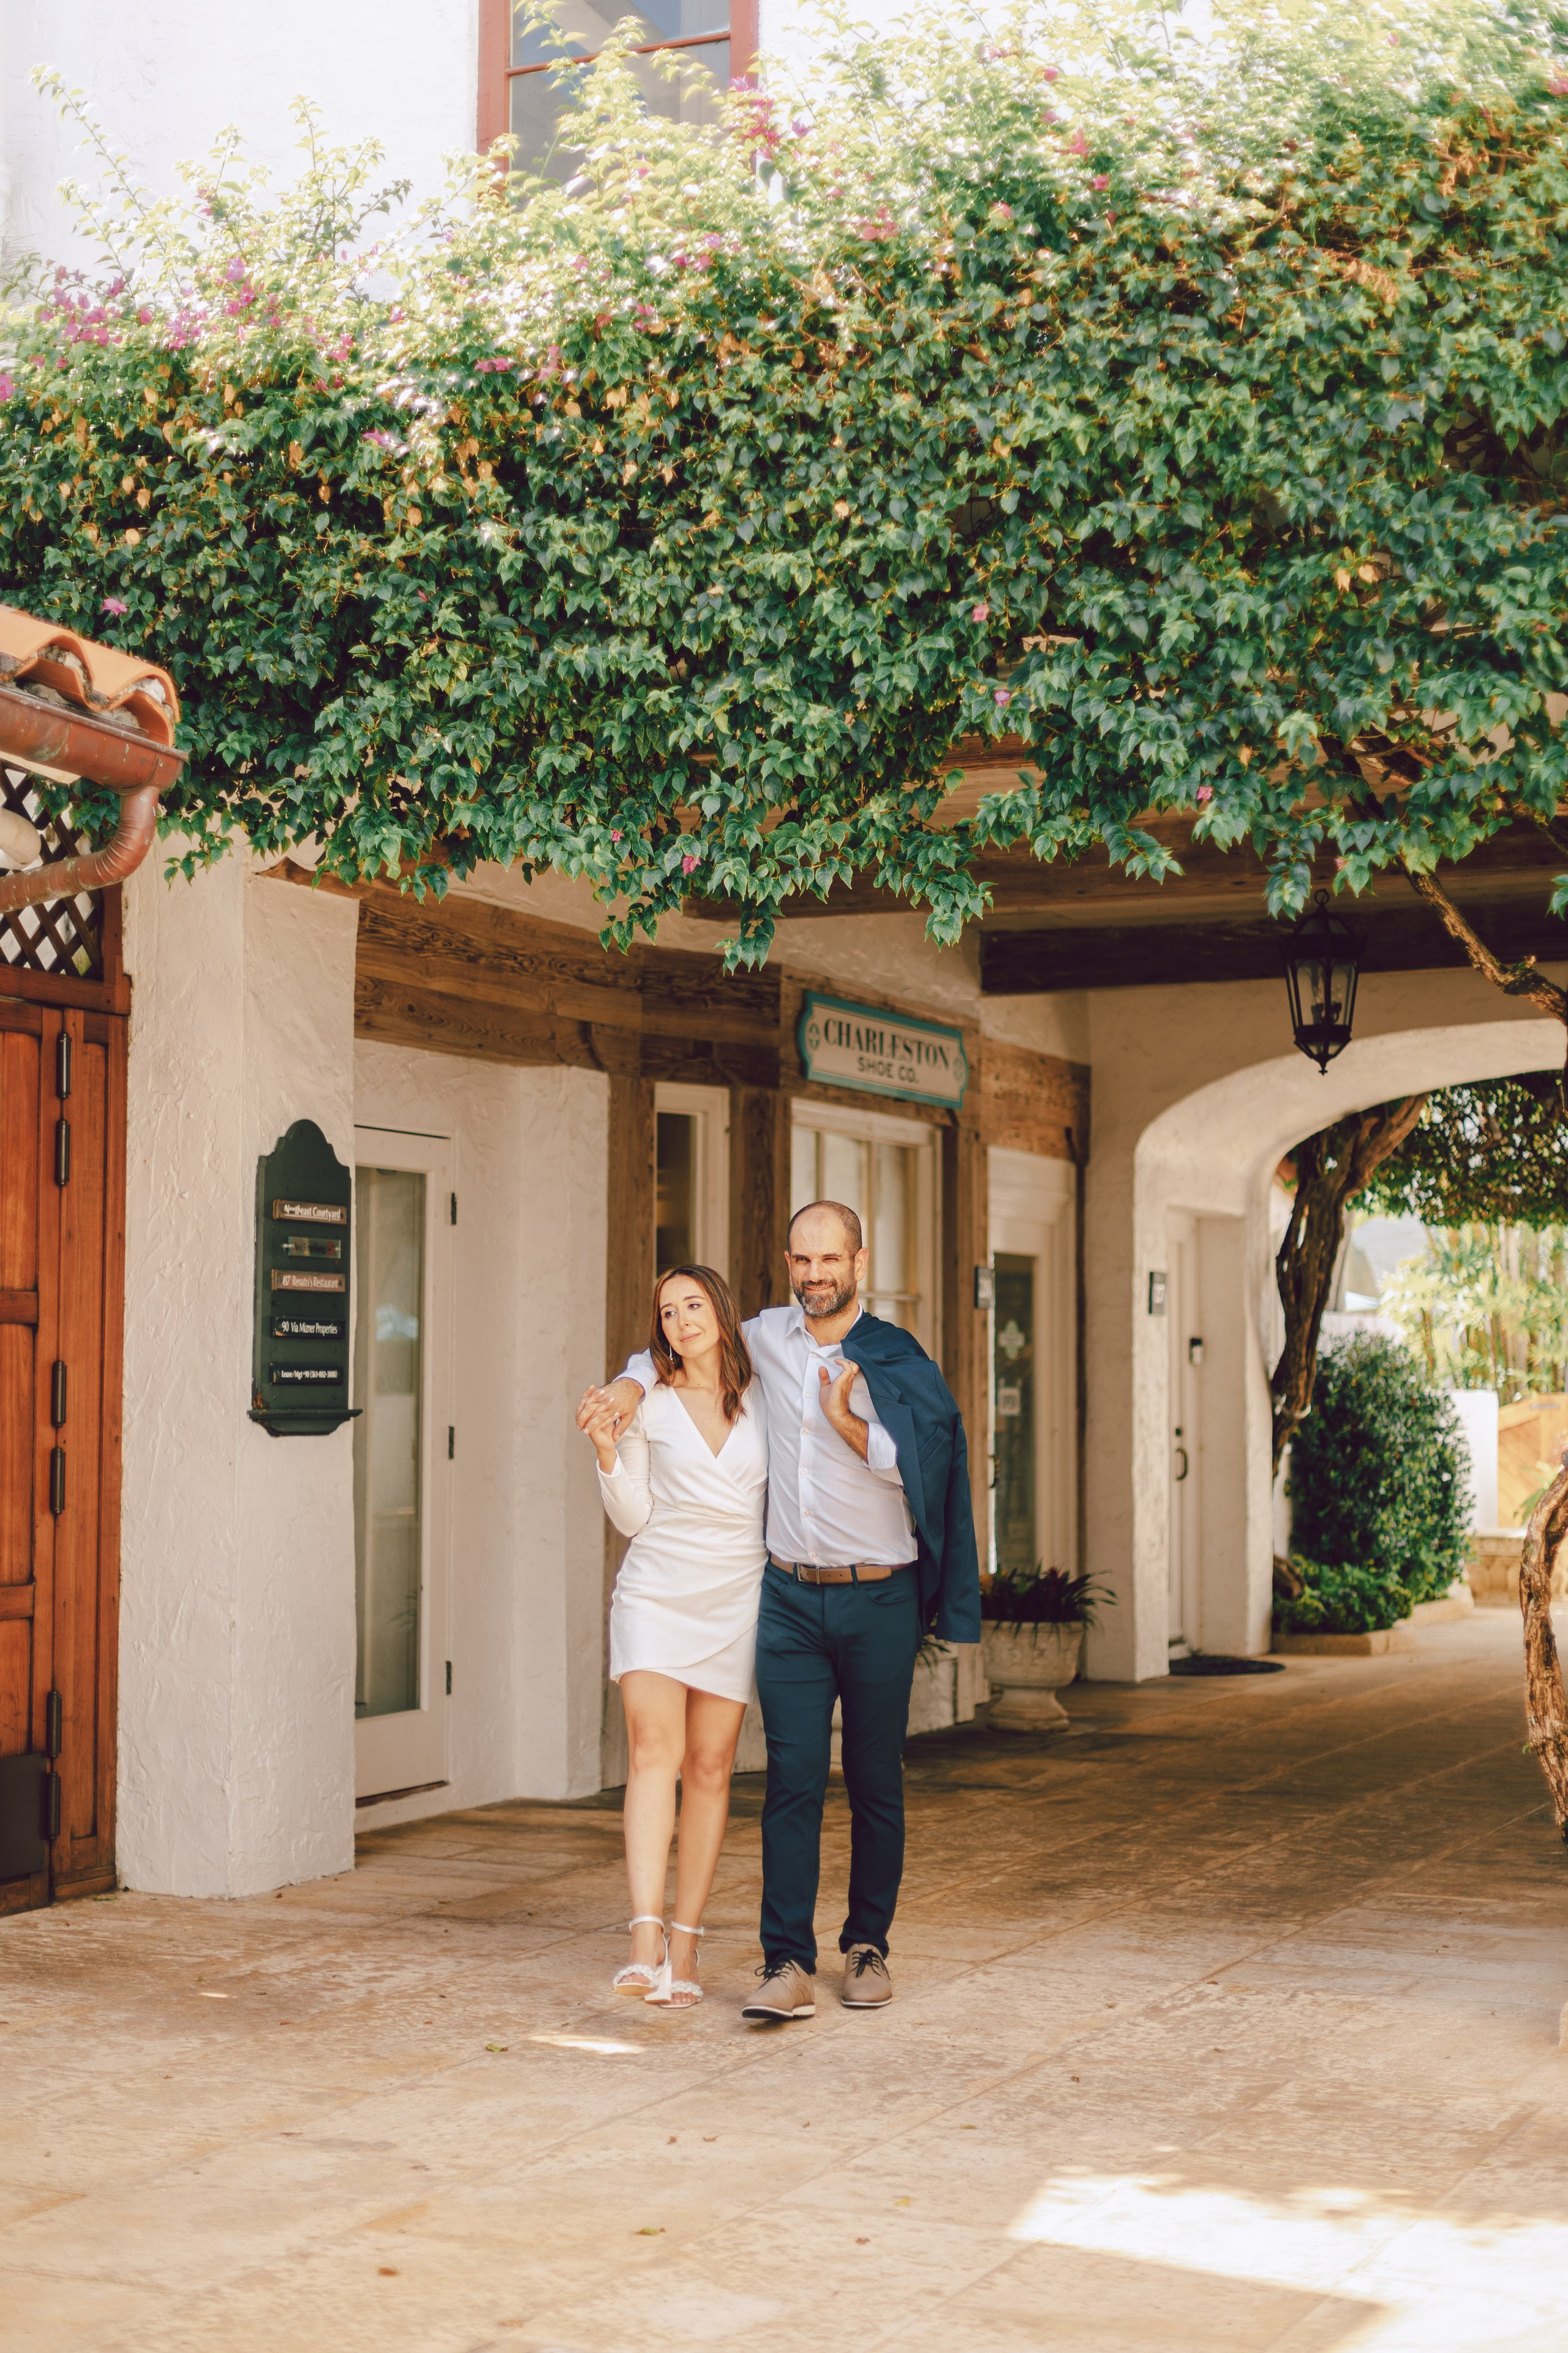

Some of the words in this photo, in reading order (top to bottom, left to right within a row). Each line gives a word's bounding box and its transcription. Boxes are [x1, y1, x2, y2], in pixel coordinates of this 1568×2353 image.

[824, 1019, 951, 1070] CHARLESTON
[858, 1056, 894, 1079] SHOE
[897, 1065, 920, 1084] CO.
[284, 1204, 311, 1216] Northeast
[312, 1206, 341, 1222] Courtyard
[283, 1275, 290, 1286] 87
[292, 1275, 313, 1287] Renato's
[314, 1276, 338, 1288] Restaurant
[282, 1321, 289, 1332] 90
[300, 1323, 315, 1333] Mizner
[315, 1323, 337, 1336] Properties
